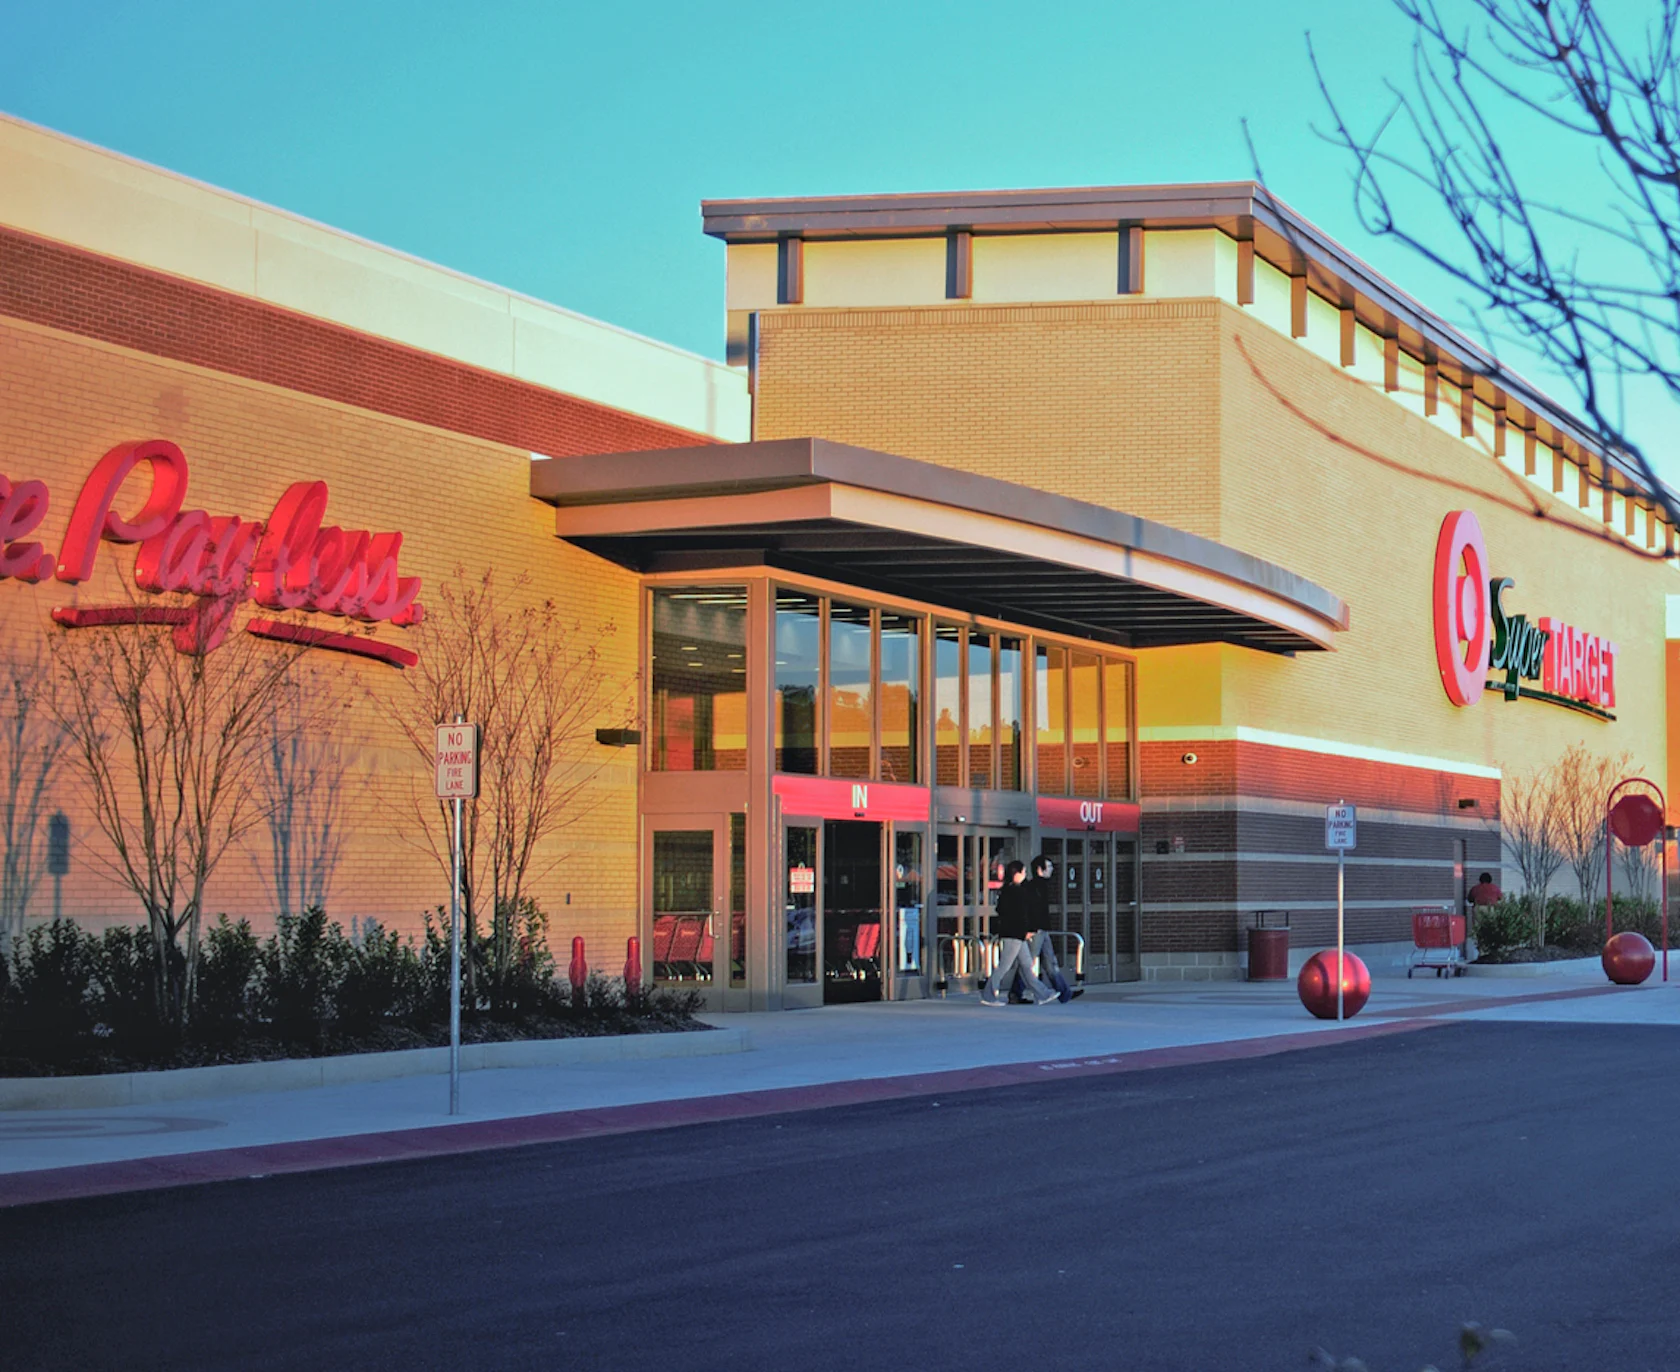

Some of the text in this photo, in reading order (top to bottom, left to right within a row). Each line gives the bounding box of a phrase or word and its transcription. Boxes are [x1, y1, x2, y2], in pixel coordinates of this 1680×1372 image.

[1539, 617, 1620, 708] TARGET
[447, 732, 464, 747] NO
[439, 751, 473, 765] PARKING
[446, 767, 463, 778] FIRE
[445, 780, 464, 791] LANE
[852, 784, 868, 808] IN
[1080, 801, 1103, 823] OUT
[1335, 809, 1347, 818] NO
